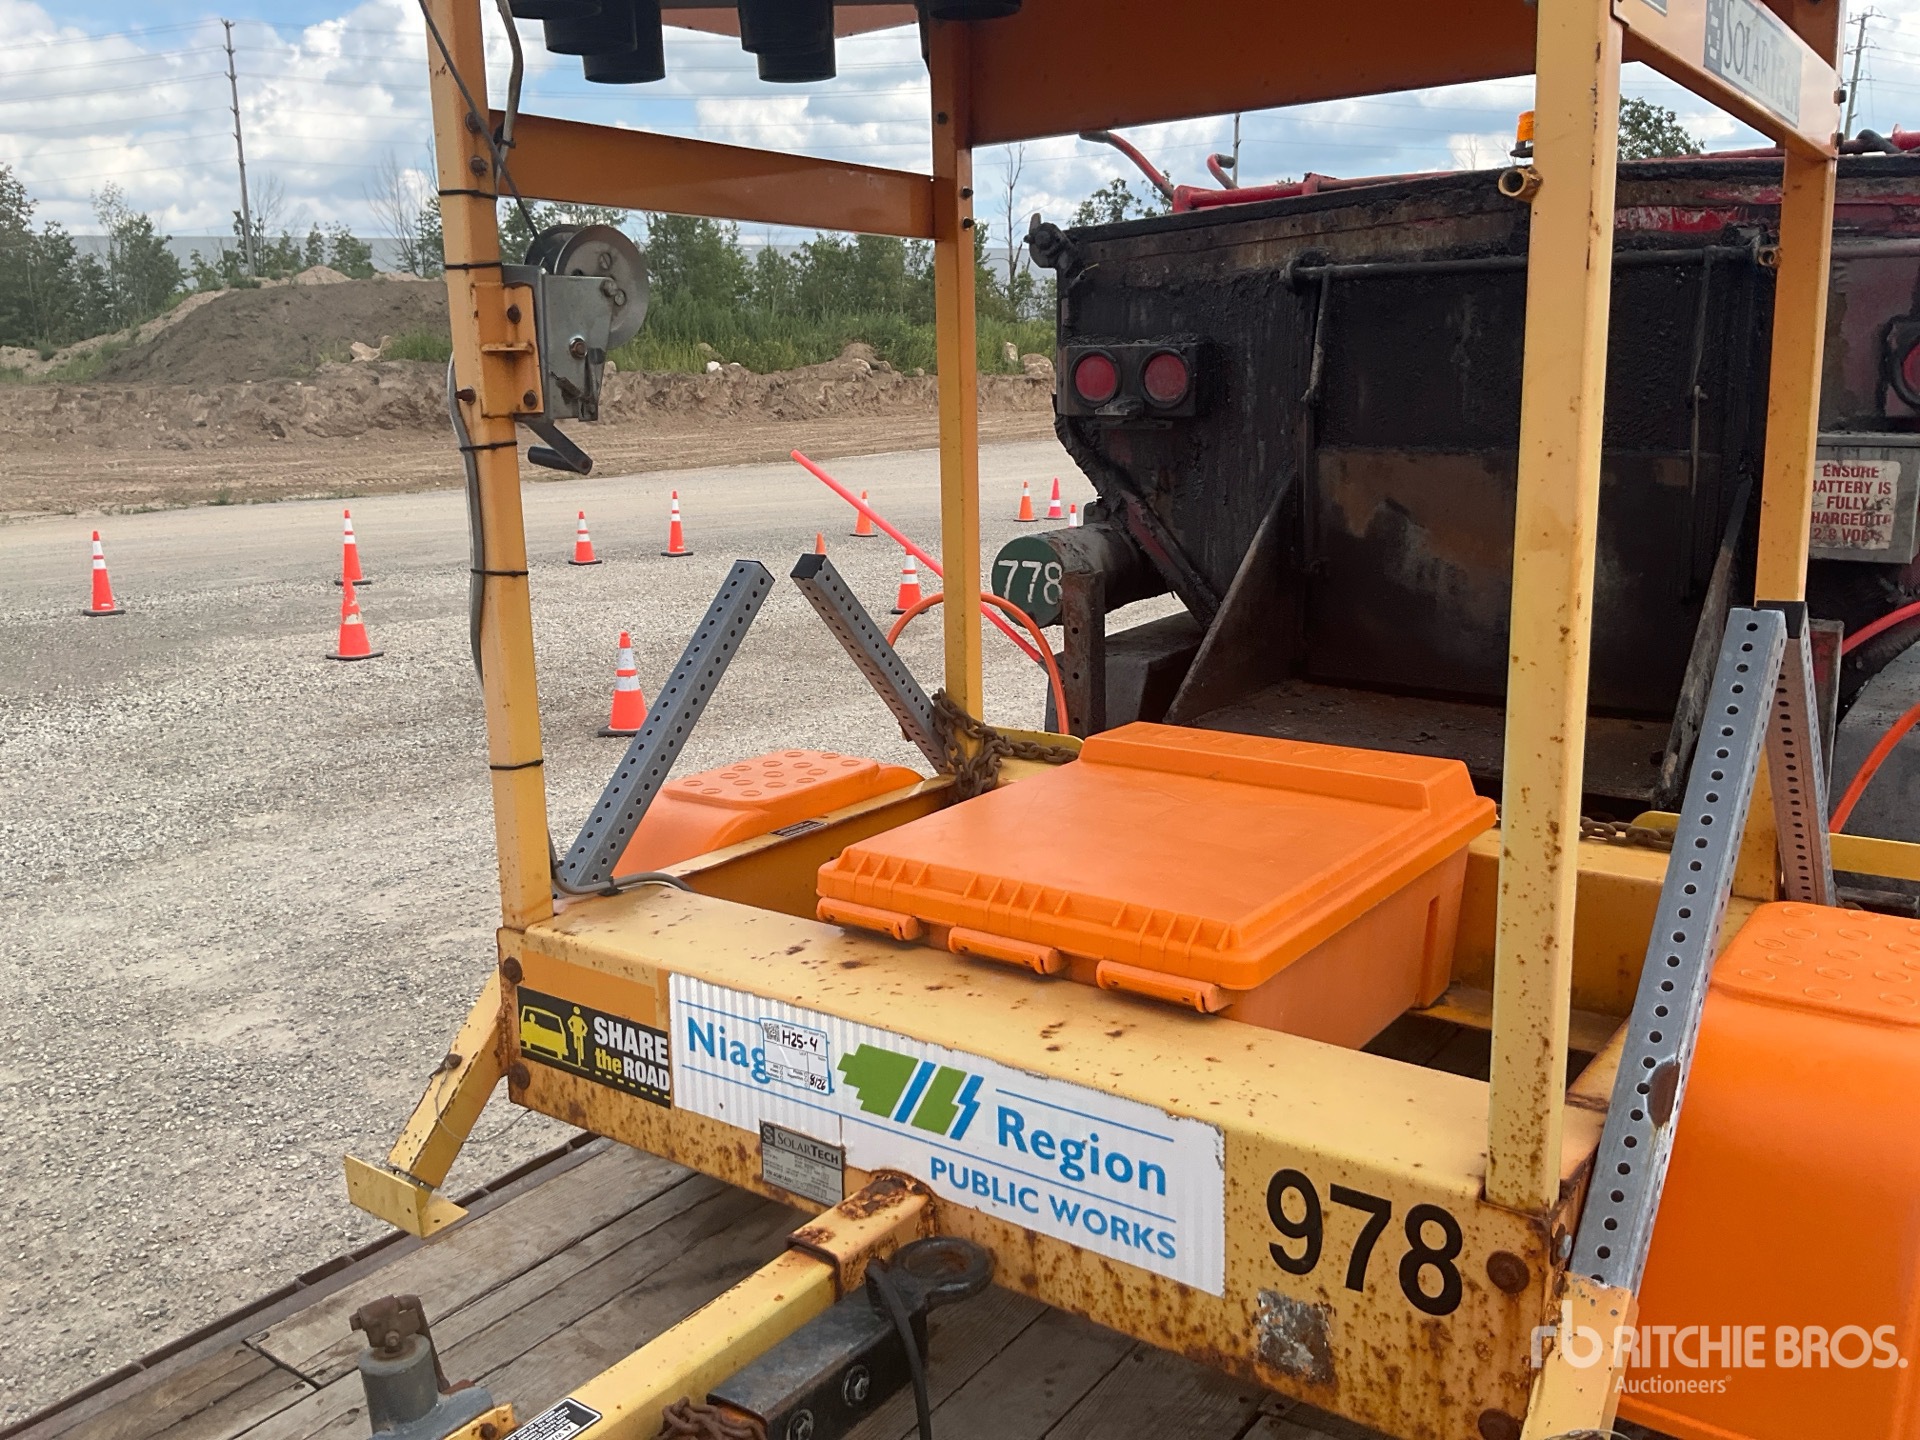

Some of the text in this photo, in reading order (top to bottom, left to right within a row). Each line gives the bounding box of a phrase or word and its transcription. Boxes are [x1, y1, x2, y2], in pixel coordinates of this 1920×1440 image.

[1822, 464, 1879, 478] ENSURE
[1878, 482, 1892, 495] IS
[1811, 511, 1867, 527] HARGED
[1826, 496, 1869, 510] FULLY
[998, 560, 1063, 605] 778
[593, 1016, 669, 1066] SHARE
[594, 1047, 670, 1091] the ROAD
[997, 1105, 1167, 1197] Region
[930, 1156, 1177, 1260] PUBLIC WORKS
[1266, 1168, 1463, 1317] 978
